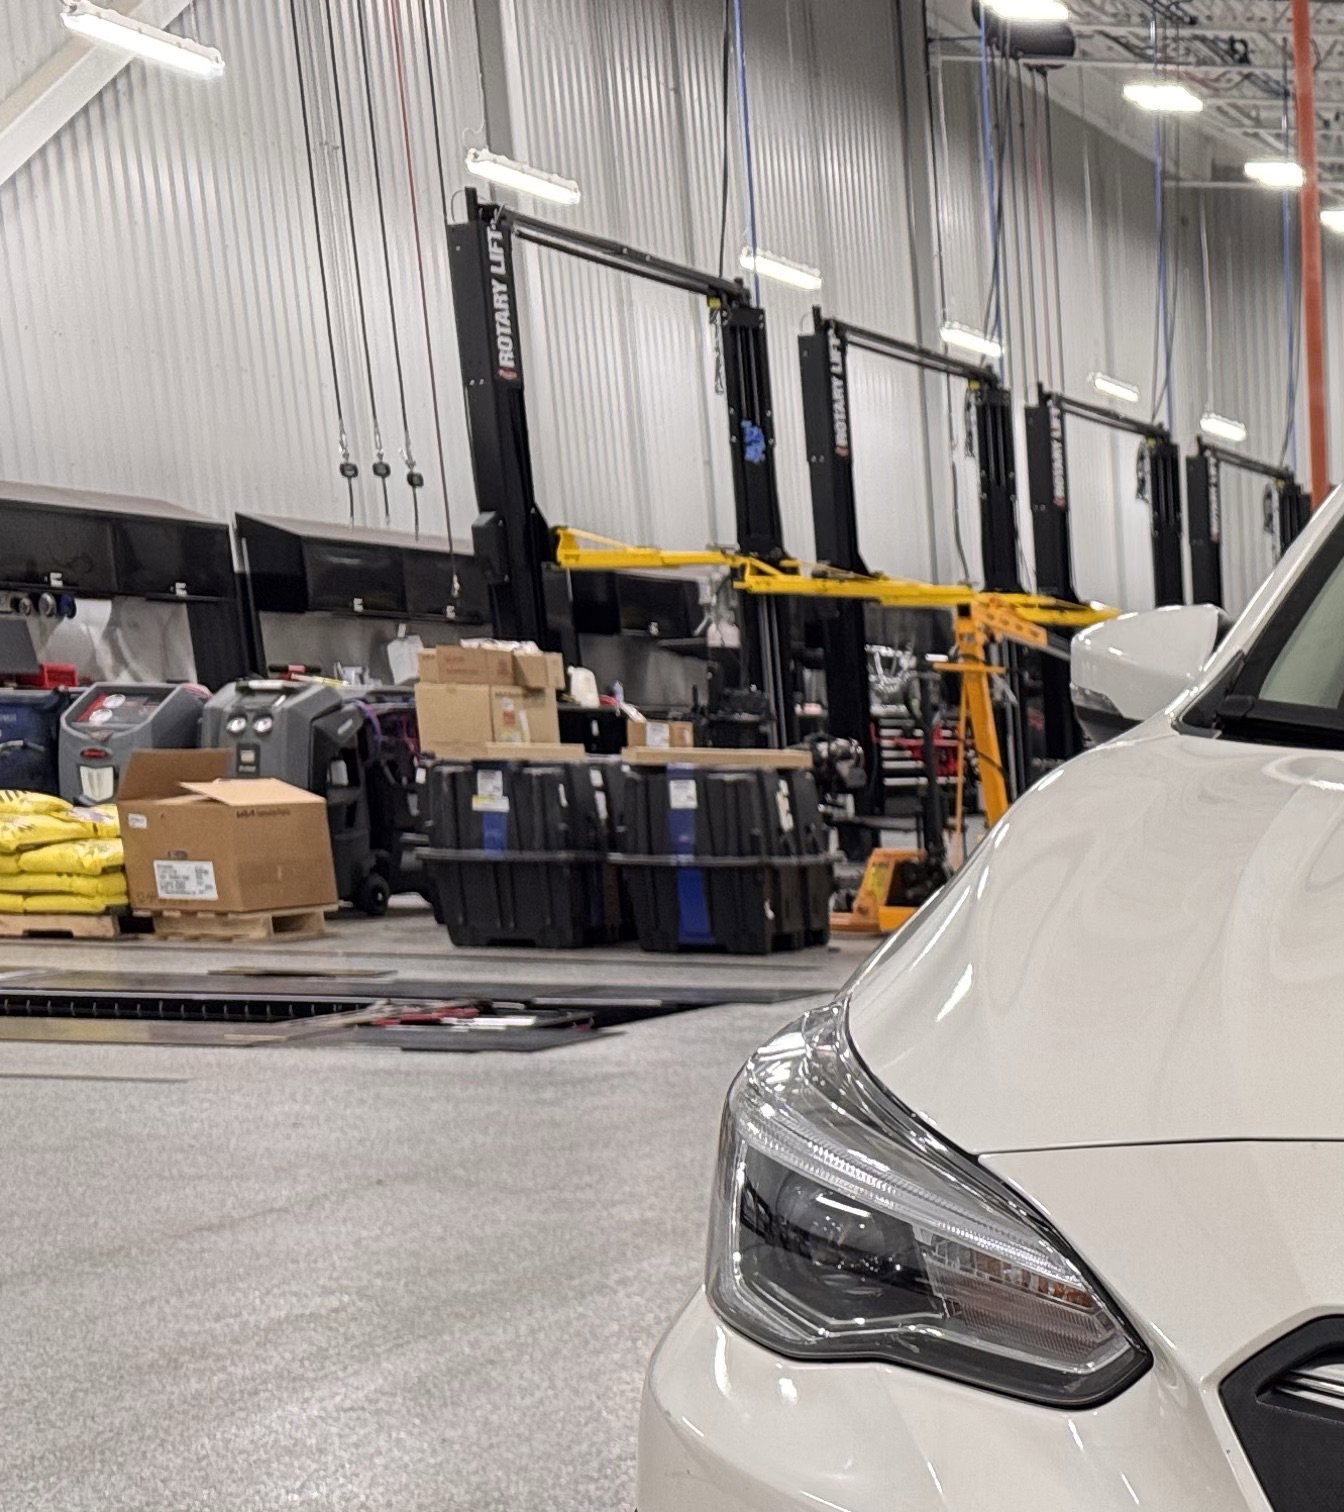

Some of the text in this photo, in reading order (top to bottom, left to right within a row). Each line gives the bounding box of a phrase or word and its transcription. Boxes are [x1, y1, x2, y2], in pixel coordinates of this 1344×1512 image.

[486, 225, 515, 369] ROTARY LIFT
[831, 375, 849, 447] ROTARY
